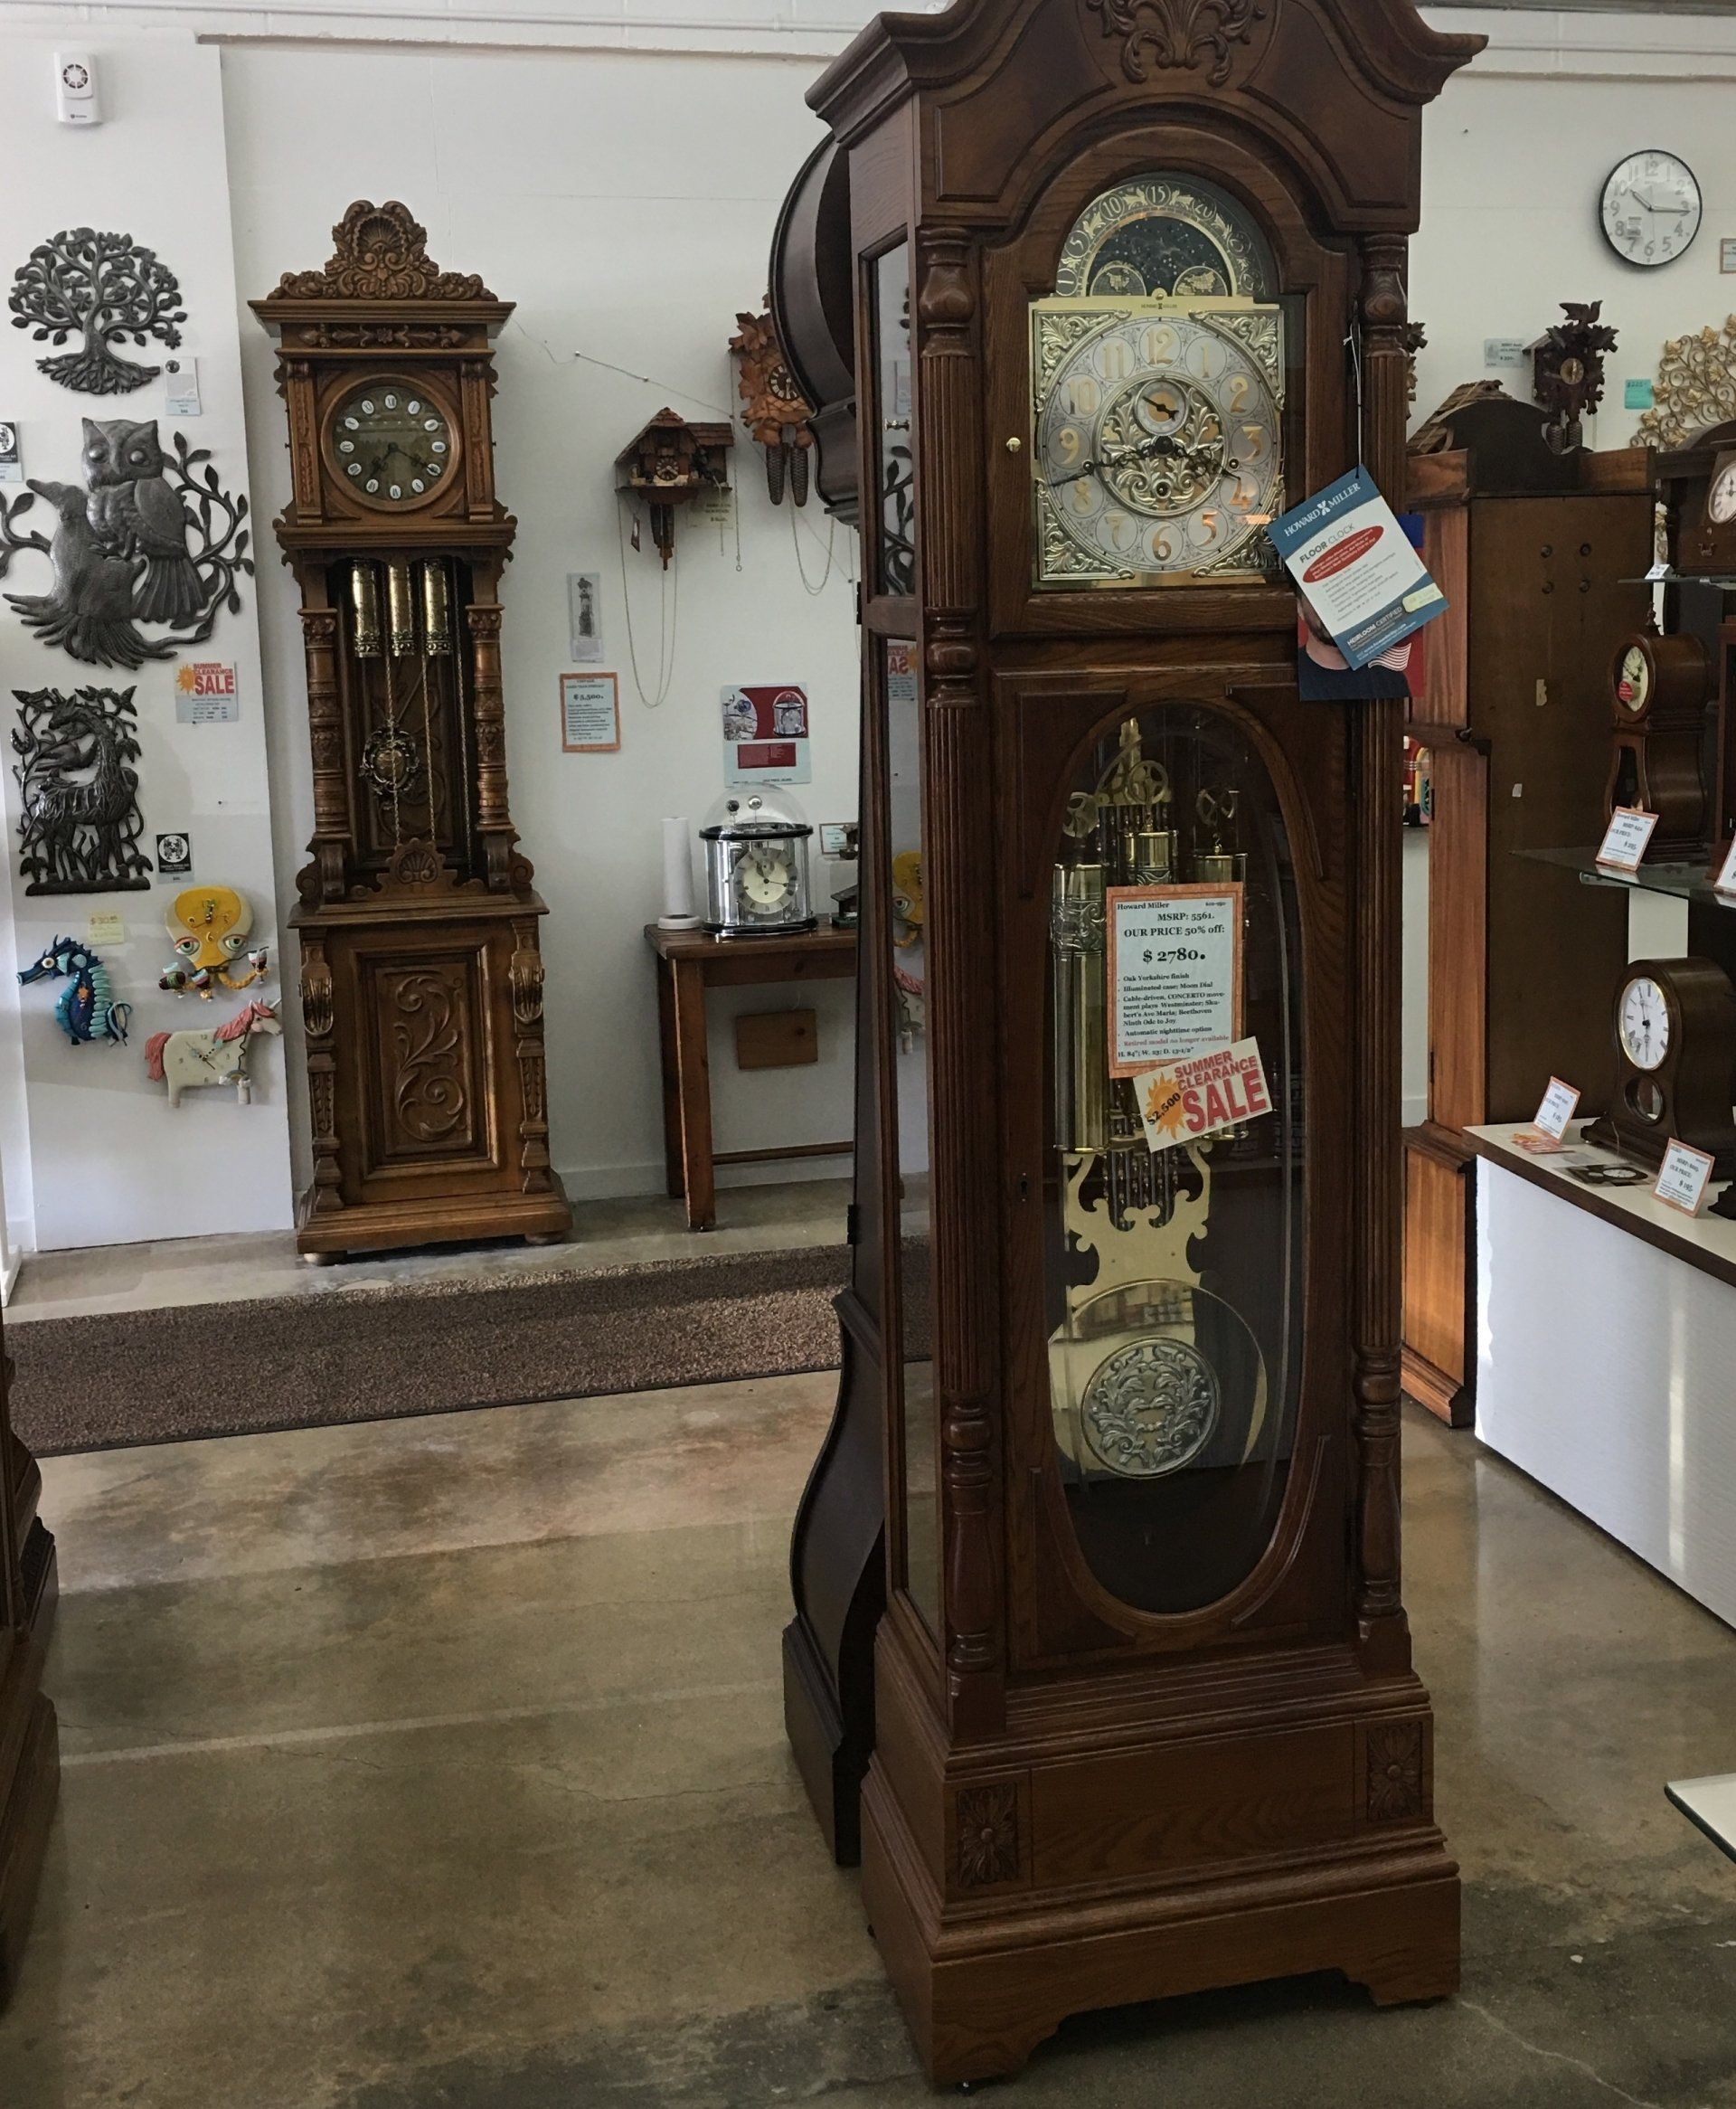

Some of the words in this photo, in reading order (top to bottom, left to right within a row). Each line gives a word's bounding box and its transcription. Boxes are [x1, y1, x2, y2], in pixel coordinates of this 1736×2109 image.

[1628, 165, 1638, 182] 11
[1646, 160, 1659, 176] 12
[1151, 185, 1166, 203] 15
[1614, 179, 1628, 196] 10
[1675, 179, 1685, 195] 2
[1102, 198, 1122, 218] 10
[1609, 200, 1620, 217] 9
[1614, 220, 1625, 237] 8
[1674, 220, 1684, 237] 4
[1069, 235, 1084, 253] 5
[1627, 236, 1637, 253] 7
[1644, 240, 1655, 257] 6
[1662, 235, 1672, 252] 5
[1146, 325, 1174, 365] 12
[1102, 342, 1125, 380] 11
[1201, 342, 1211, 379] 1
[1066, 378, 1097, 415] 10
[1229, 375, 1249, 413] 2
[1059, 427, 1079, 465] 9
[1241, 425, 1264, 463] 3
[1072, 478, 1091, 514] 8
[1229, 478, 1252, 511] 4
[1284, 508, 1321, 536] HOWARD
[1327, 482, 1361, 507] MILLER
[1104, 514, 1127, 551] 7
[1200, 511, 1218, 546] 5
[1152, 524, 1172, 561] 6
[1299, 541, 1328, 563] FLOOR
[1327, 523, 1355, 544] CLOCK
[1346, 623, 1377, 646] HEIRLOOM
[1375, 606, 1402, 627] CERTIFIED
[194, 675, 235, 695] SALE
[1157, 913, 1189, 922] MSRP:
[1191, 912, 1215, 921] 5561.
[205, 932, 214, 943] 6
[1124, 928, 1147, 938] OUR
[1150, 927, 1183, 936] PRICE
[1184, 925, 1206, 936] 50%
[1208, 924, 1225, 933] off:
[1142, 949, 1153, 965] $
[1157, 947, 1206, 964] 2780.
[1123, 984, 1162, 992] Illuminated
[1123, 994, 1166, 1002] Cable-driven,
[1141, 1002, 1159, 1010] plays
[1160, 1000, 1203, 1008] Westminster;
[1159, 1027, 1190, 1036] nighttime
[1179, 1036, 1200, 1045] longer
[1174, 1050, 1233, 1079] SUMMER
[1177, 1054, 1259, 1091] CLEARANCE
[1146, 1092, 1181, 1125] $2,500
[1182, 1068, 1268, 1132] SALE
